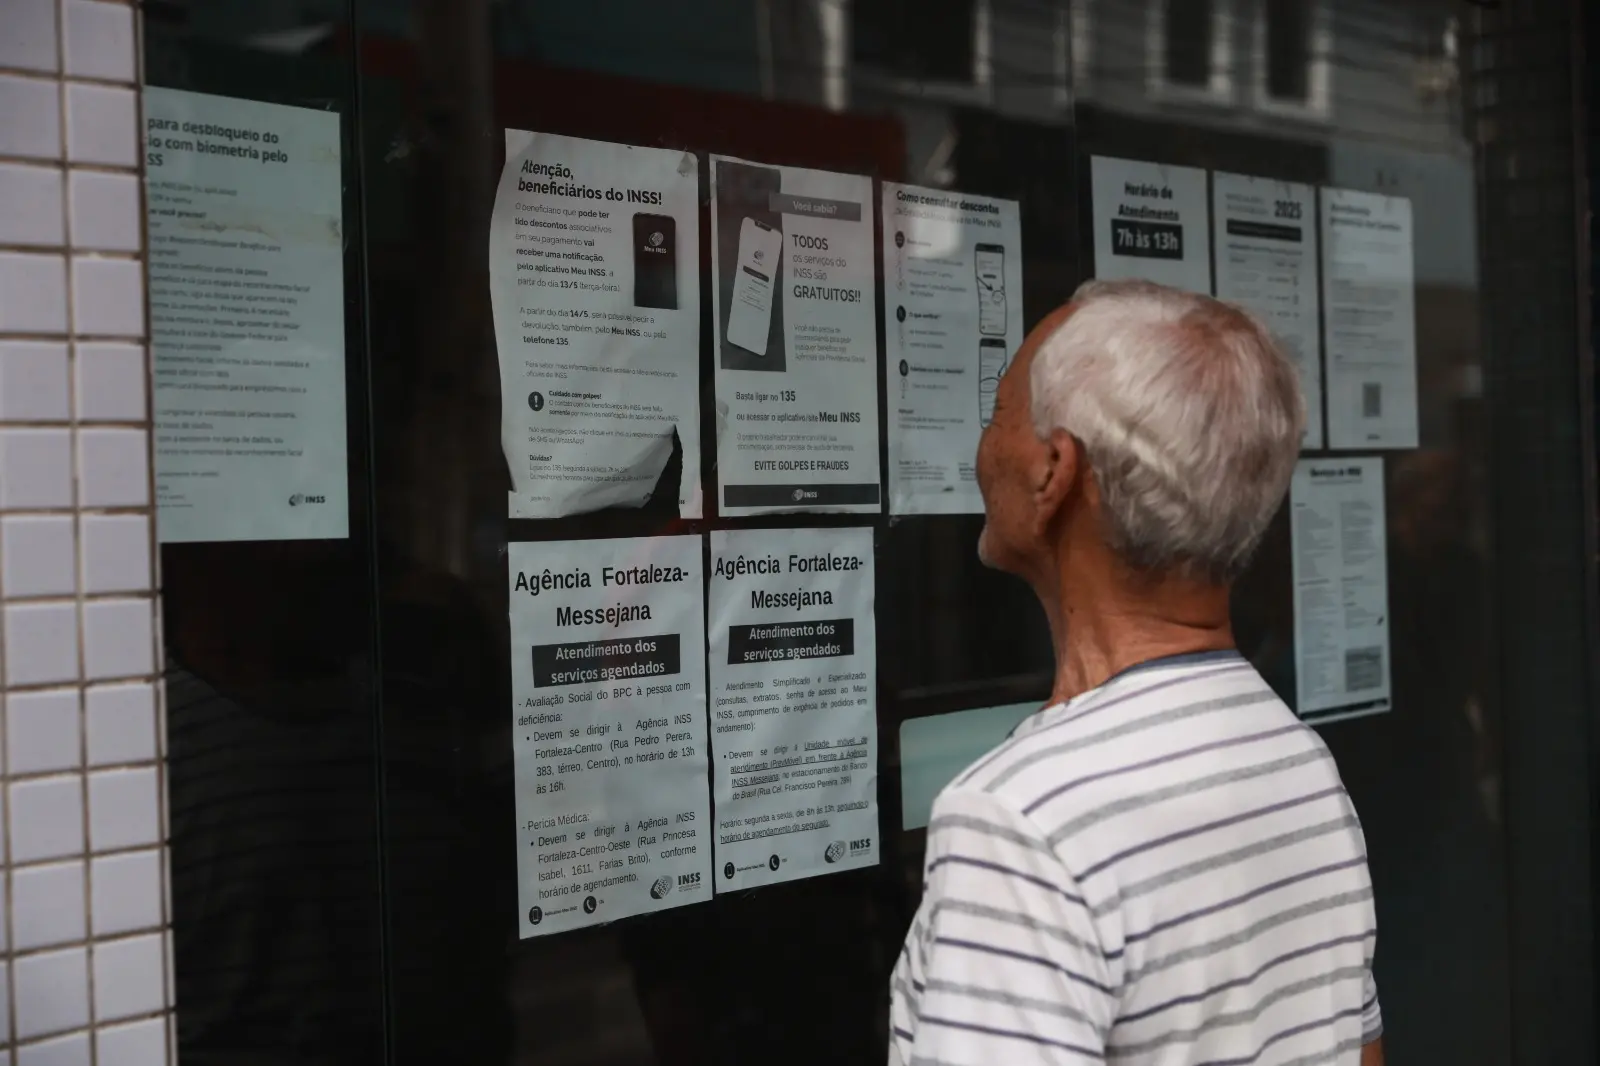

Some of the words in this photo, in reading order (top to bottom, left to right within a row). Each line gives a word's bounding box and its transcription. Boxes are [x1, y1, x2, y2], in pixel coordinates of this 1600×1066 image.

[148, 117, 178, 131] para
[182, 122, 259, 142] desbloqueio
[262, 131, 279, 144] do
[165, 139, 193, 151] com
[197, 140, 259, 160] biometria
[262, 148, 288, 164] pelo
[521, 160, 574, 180] Atenção,
[518, 177, 602, 200] beneficiários
[606, 188, 624, 201] do
[627, 189, 662, 206] INSS!
[896, 190, 918, 203] Como
[563, 209, 576, 217] que
[578, 210, 597, 218] pode
[793, 200, 811, 212] Você
[813, 204, 837, 214] sabia?
[515, 218, 528, 226] tido
[530, 218, 567, 230] descontos
[542, 236, 583, 246] pagamento
[792, 234, 828, 250] TODOS
[1118, 228, 1133, 246] 7h
[1136, 225, 1150, 248] às
[1154, 232, 1179, 250] 13h
[516, 248, 544, 257] receber
[793, 254, 802, 263] os
[804, 255, 834, 267] serviços
[835, 257, 846, 267] do
[516, 262, 534, 271] pelo
[535, 264, 569, 274] aplicativo
[571, 267, 586, 275] Meu
[794, 267, 812, 279] INSS
[537, 279, 546, 287] do
[560, 280, 578, 289] 13/5
[793, 285, 861, 302] GRATUITOS!!
[611, 327, 624, 335] Meu
[523, 336, 554, 345] telefone
[736, 392, 754, 401] Basta
[755, 392, 768, 403] ligar
[780, 390, 796, 402] 135
[819, 411, 838, 422] Meu
[840, 412, 861, 423] INSS
[754, 460, 777, 471] EVITE
[778, 460, 809, 471] GOLPES
[810, 461, 816, 471] E
[816, 460, 849, 471] FRAUDES
[305, 495, 326, 504] INSS
[804, 490, 818, 499] INSS
[715, 555, 780, 580] Agência
[789, 553, 863, 572] Fortaleza-
[515, 568, 591, 596] Agência
[602, 564, 689, 586] Fortaleza-
[751, 588, 833, 611] Messejana
[557, 603, 651, 627] Messejana
[750, 626, 814, 640] Atendimento
[816, 623, 835, 635] dos
[556, 644, 632, 660] Atendimento
[635, 640, 656, 653] dos
[744, 647, 784, 662] serviços
[787, 643, 840, 659] agendados
[552, 668, 598, 683] serviços
[600, 661, 665, 680] agendados
[726, 681, 764, 691] Atendimento
[773, 678, 810, 688] Simplificado
[526, 695, 564, 708] Avaliação
[568, 691, 592, 703] Social
[597, 689, 608, 699] do
[614, 687, 632, 698] BPC
[646, 684, 672, 697] pessoa
[676, 682, 690, 691] com
[786, 691, 804, 700] senha
[818, 688, 836, 696] acesso
[738, 707, 779, 718] cumprimento
[783, 705, 790, 713] de
[518, 713, 563, 726] deficiência:
[534, 731, 562, 742] Devem
[570, 729, 580, 737] se
[587, 724, 610, 736] dirigir
[636, 719, 668, 731] Agência
[674, 714, 692, 724] INSS
[535, 743, 602, 759] Fortaleza-Centro
[610, 739, 628, 752] (Rua
[634, 734, 659, 746] Pedro
[624, 756, 633, 764] no
[636, 751, 664, 763] horário
[668, 749, 678, 759] de
[682, 746, 695, 757] 13h
[729, 750, 753, 760] Devem
[730, 762, 768, 774] atendimento
[536, 784, 546, 794] às
[732, 778, 749, 788] INSS
[733, 792, 740, 800] do
[741, 789, 757, 799] Brasil
[784, 782, 816, 792] Francisco
[744, 815, 770, 826] segunda
[538, 834, 566, 847] Devem
[575, 831, 586, 840] se
[594, 825, 615, 838] dirigir
[638, 817, 668, 831] Agência
[676, 812, 695, 823] INSS
[720, 832, 741, 844] horário
[743, 832, 750, 840] de
[850, 838, 871, 850] INSS
[538, 840, 630, 863] Fortaleza-Centro-Oeste
[638, 836, 656, 848] (Rua
[663, 829, 696, 842] Princesa
[600, 859, 623, 871] Farias
[660, 845, 696, 858] conforme
[678, 872, 700, 885] INSS
[539, 887, 568, 900] horário
[570, 883, 580, 893] de
